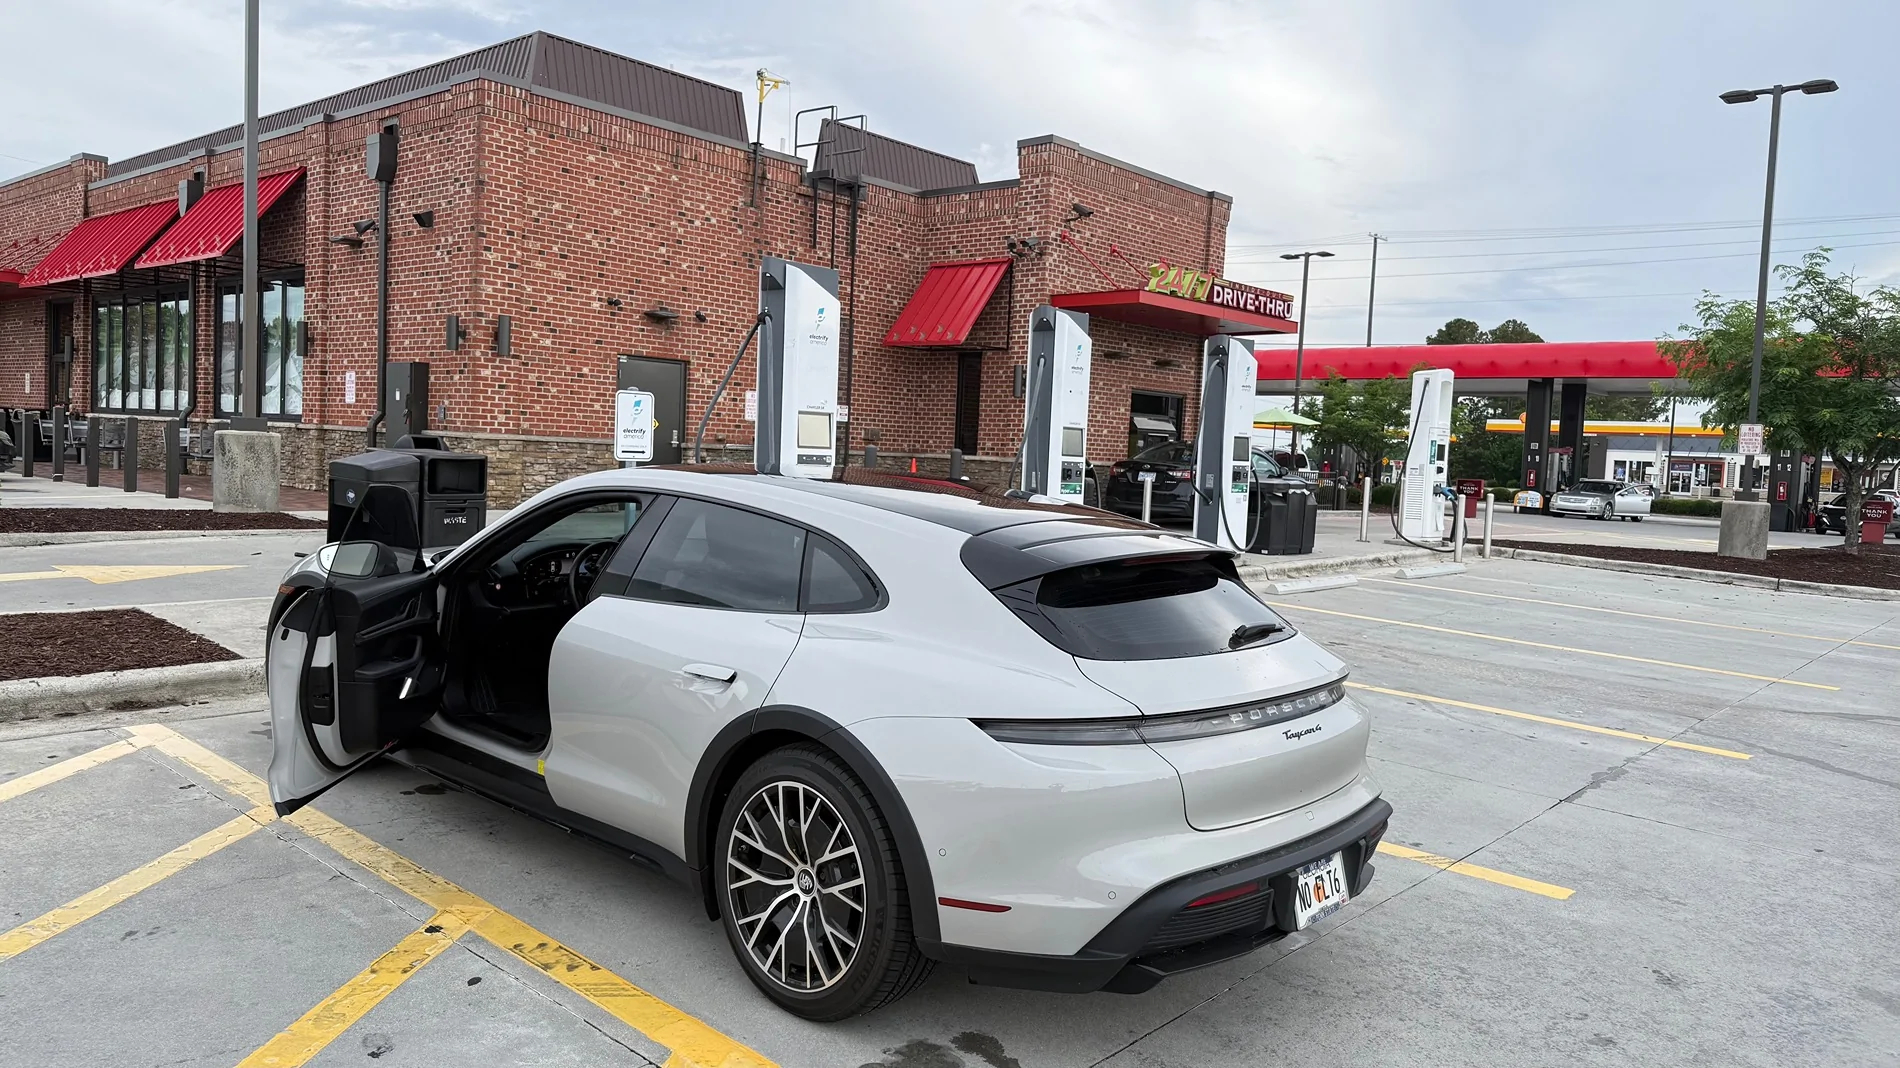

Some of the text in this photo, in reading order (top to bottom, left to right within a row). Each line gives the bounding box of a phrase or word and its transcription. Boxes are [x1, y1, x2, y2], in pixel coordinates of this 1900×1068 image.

[1152, 263, 1213, 301] 24/7
[1213, 285, 1293, 319] DRIVE-THRU
[443, 516, 467, 524] WASTE
[1229, 691, 1327, 724] PORSCHE
[1297, 867, 1341, 912] NO FLT6
